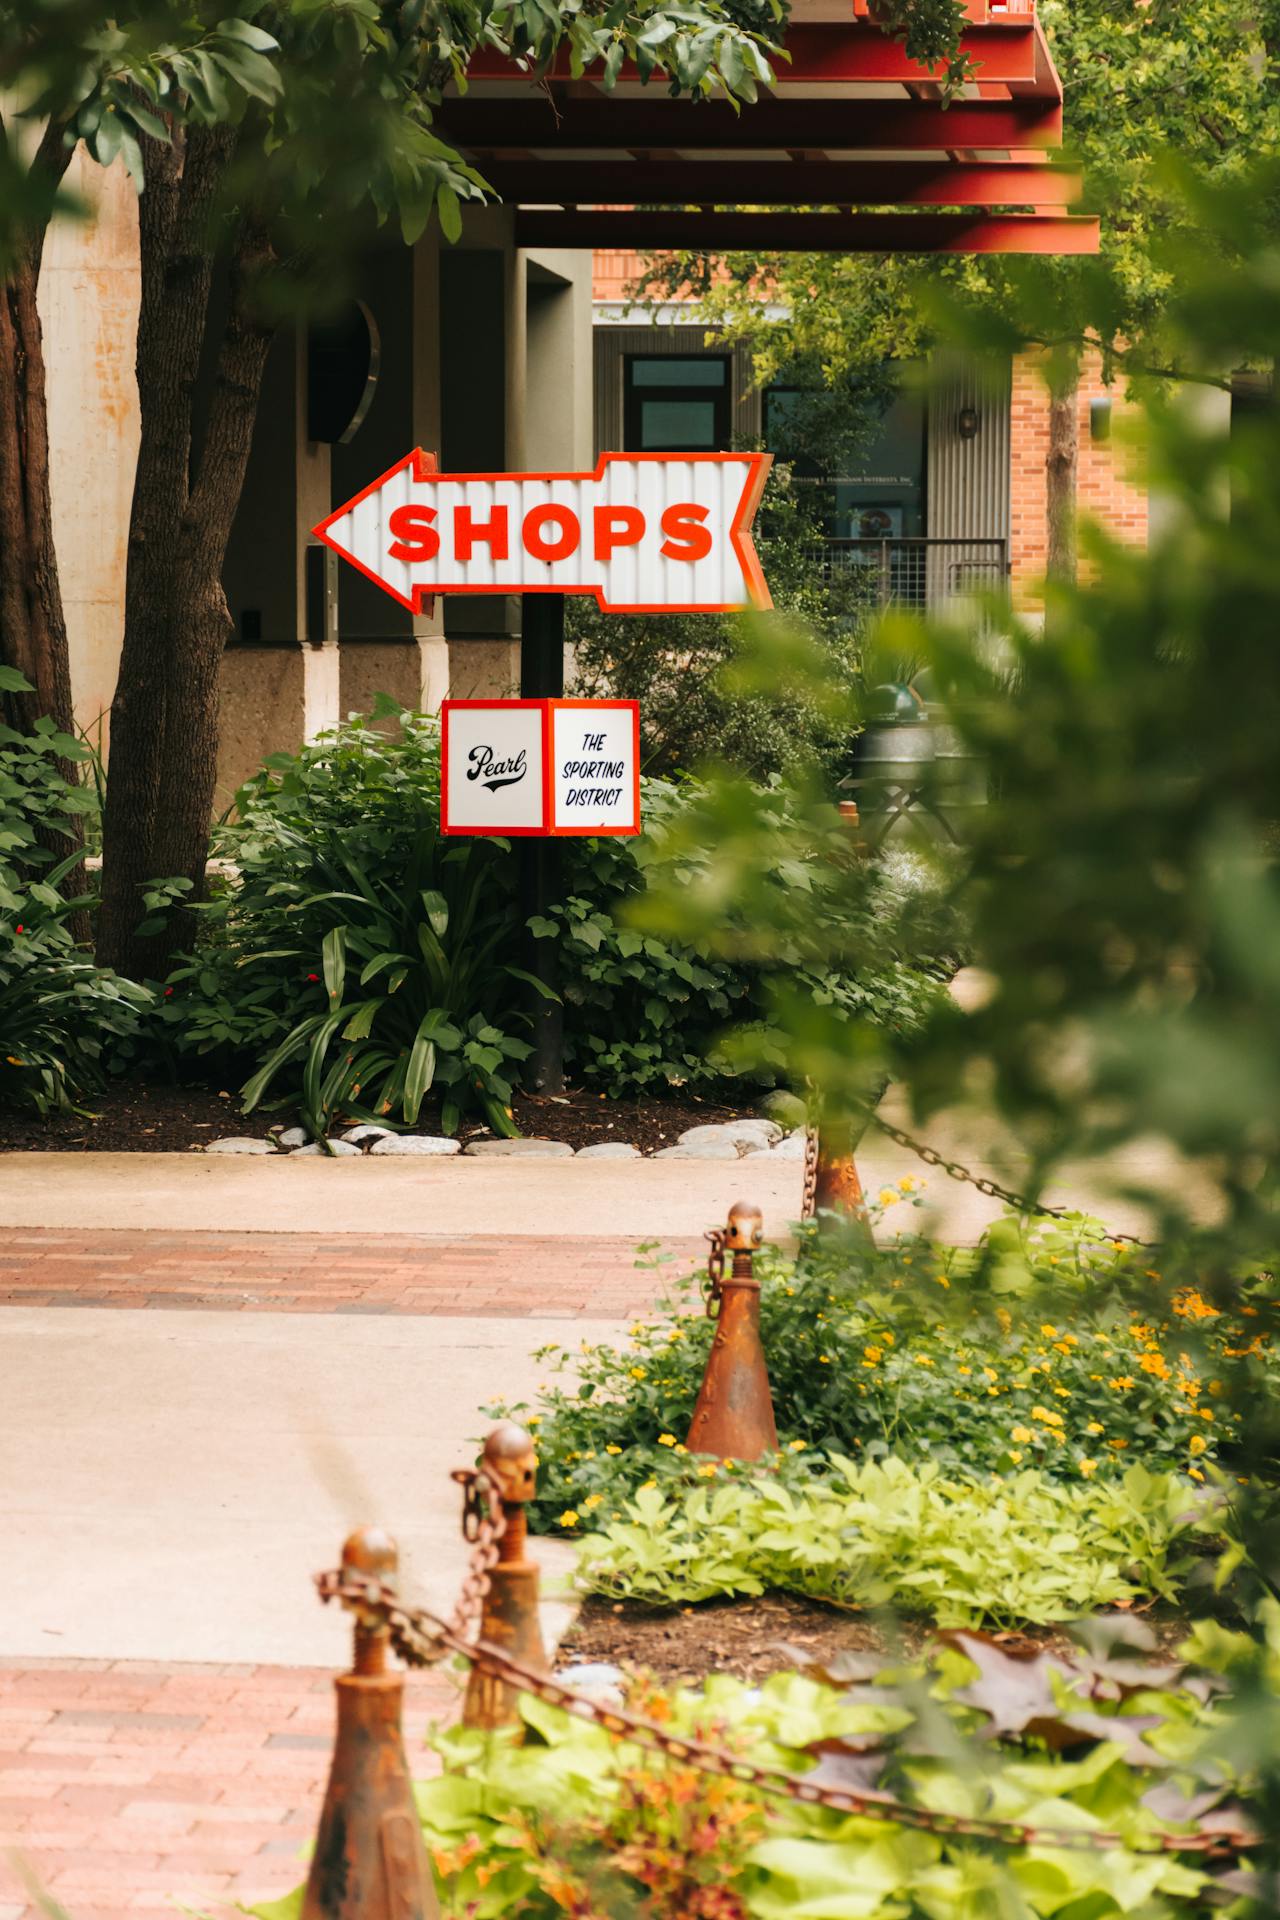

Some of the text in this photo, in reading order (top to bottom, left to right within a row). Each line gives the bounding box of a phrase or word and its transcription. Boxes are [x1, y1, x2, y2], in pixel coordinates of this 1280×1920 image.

[387, 502, 713, 563] SHOPS
[582, 733, 608, 752] THE
[466, 745, 528, 793] Pearl
[562, 760, 625, 779] SPORTING
[565, 788, 623, 807] DISTRICT
